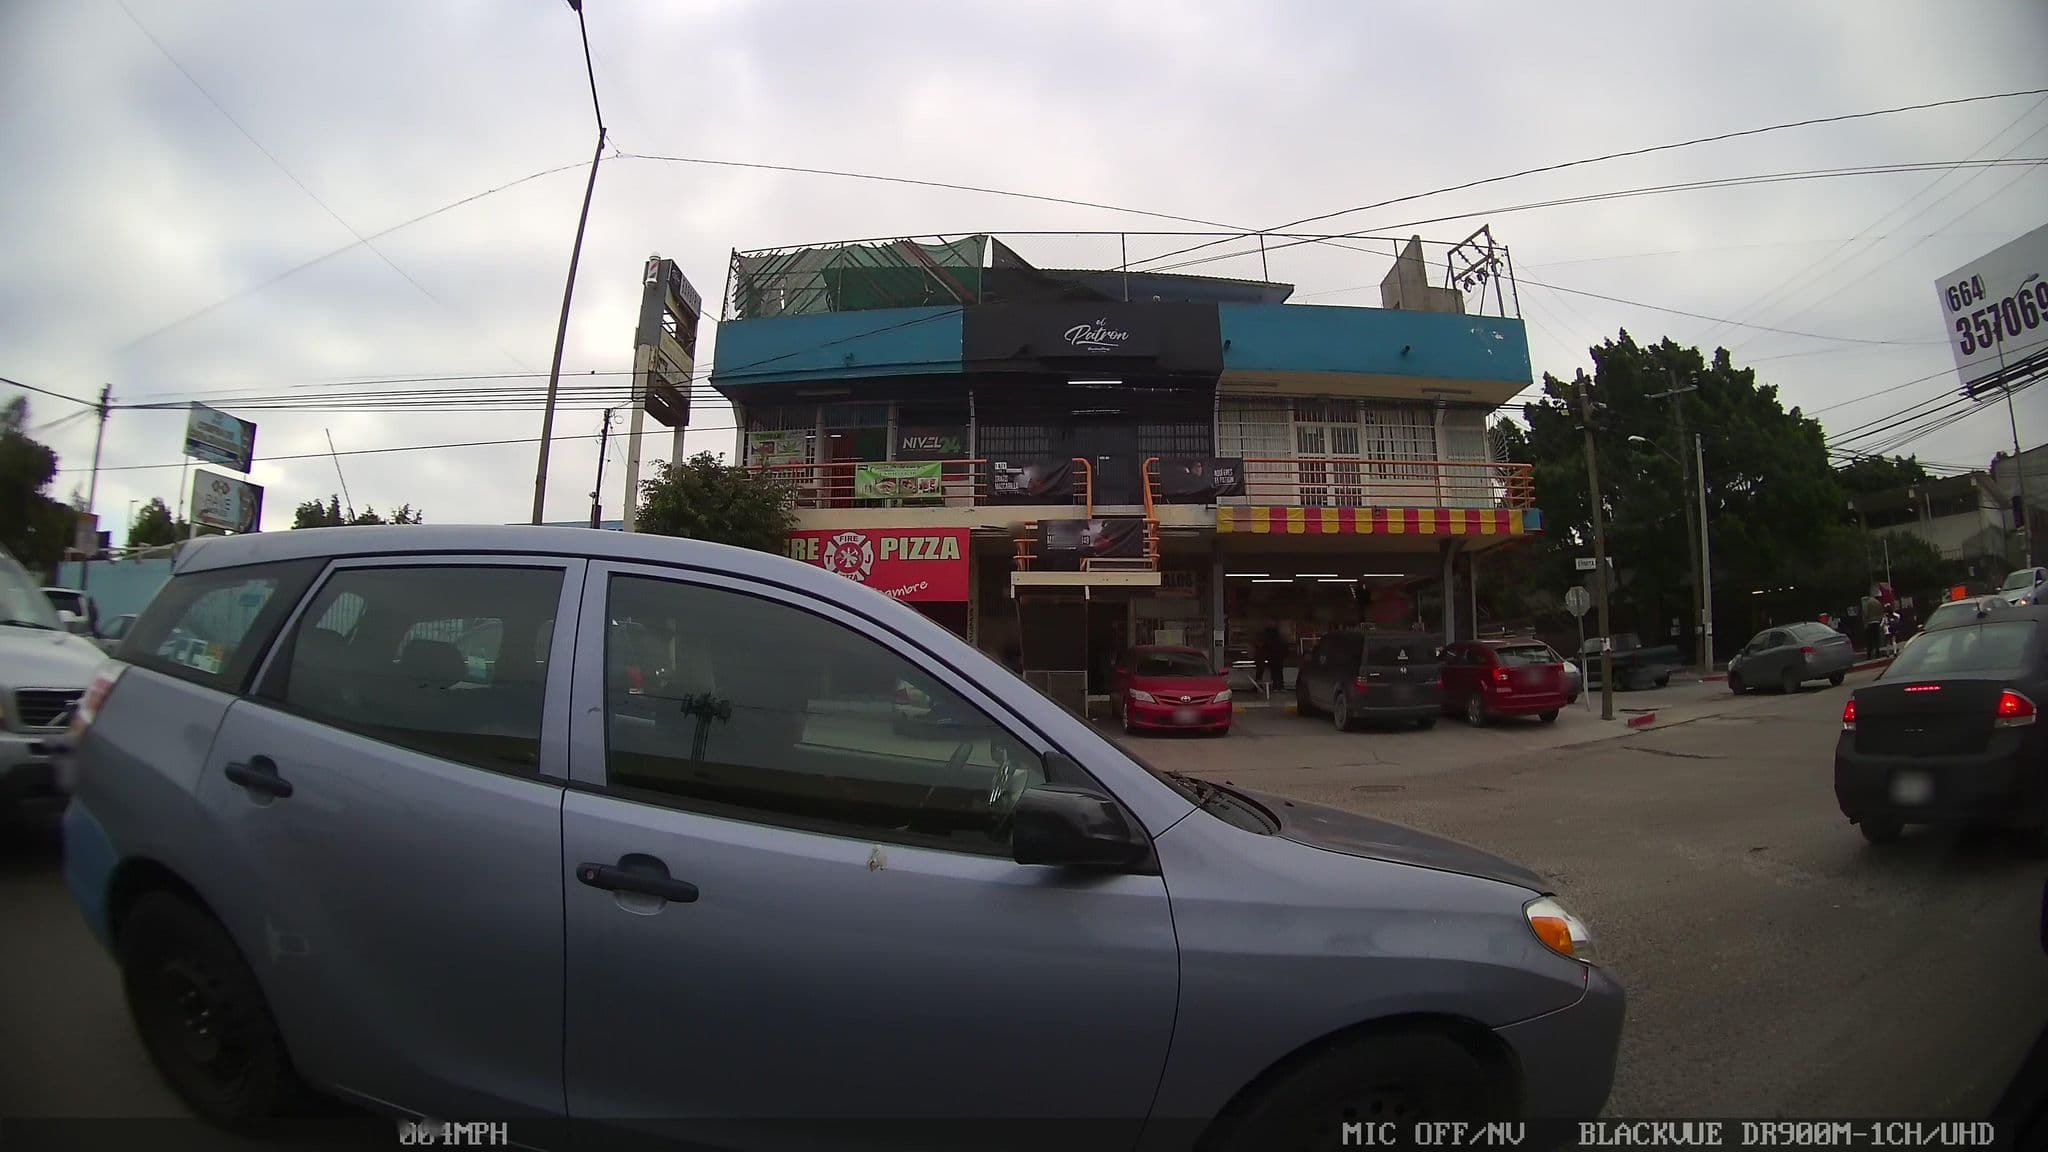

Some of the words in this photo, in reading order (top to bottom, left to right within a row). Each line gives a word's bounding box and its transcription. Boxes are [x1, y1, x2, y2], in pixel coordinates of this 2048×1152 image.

[1945, 272, 1987, 314] (664)
[839, 535, 859, 543] FIRE
[880, 536, 960, 561] PIZZA
[826, 554, 833, 565] T
[865, 553, 871, 564] J
[881, 580, 928, 598] ambre
